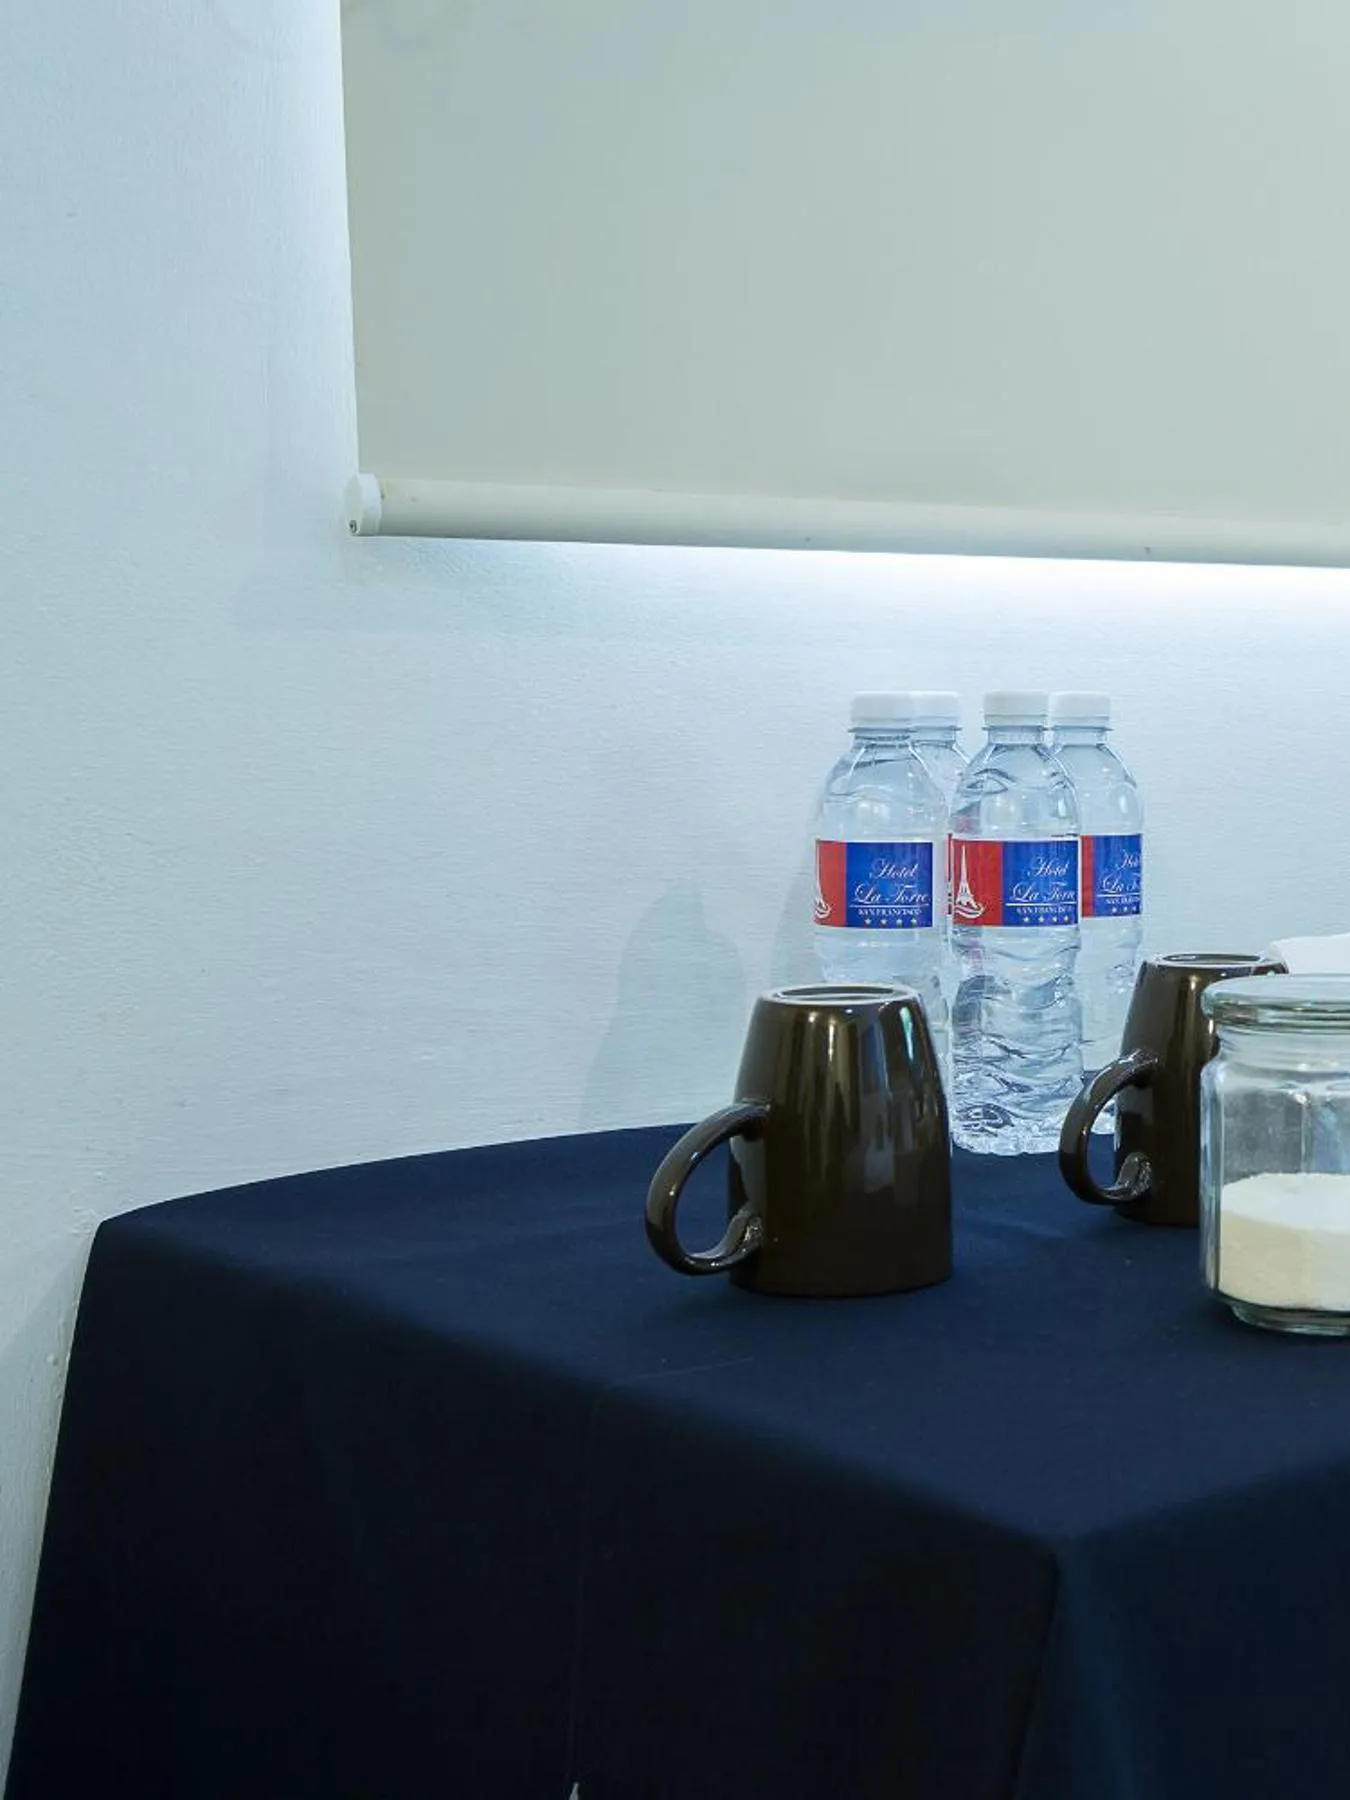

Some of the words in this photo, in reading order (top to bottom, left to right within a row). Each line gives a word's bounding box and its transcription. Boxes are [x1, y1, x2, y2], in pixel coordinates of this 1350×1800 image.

[869, 858, 919, 880] Hotel
[1027, 856, 1069, 877] Hotel
[855, 881, 881, 904] La
[888, 883, 930, 904] Torre
[1011, 881, 1039, 903] La
[1101, 872, 1125, 894] La
